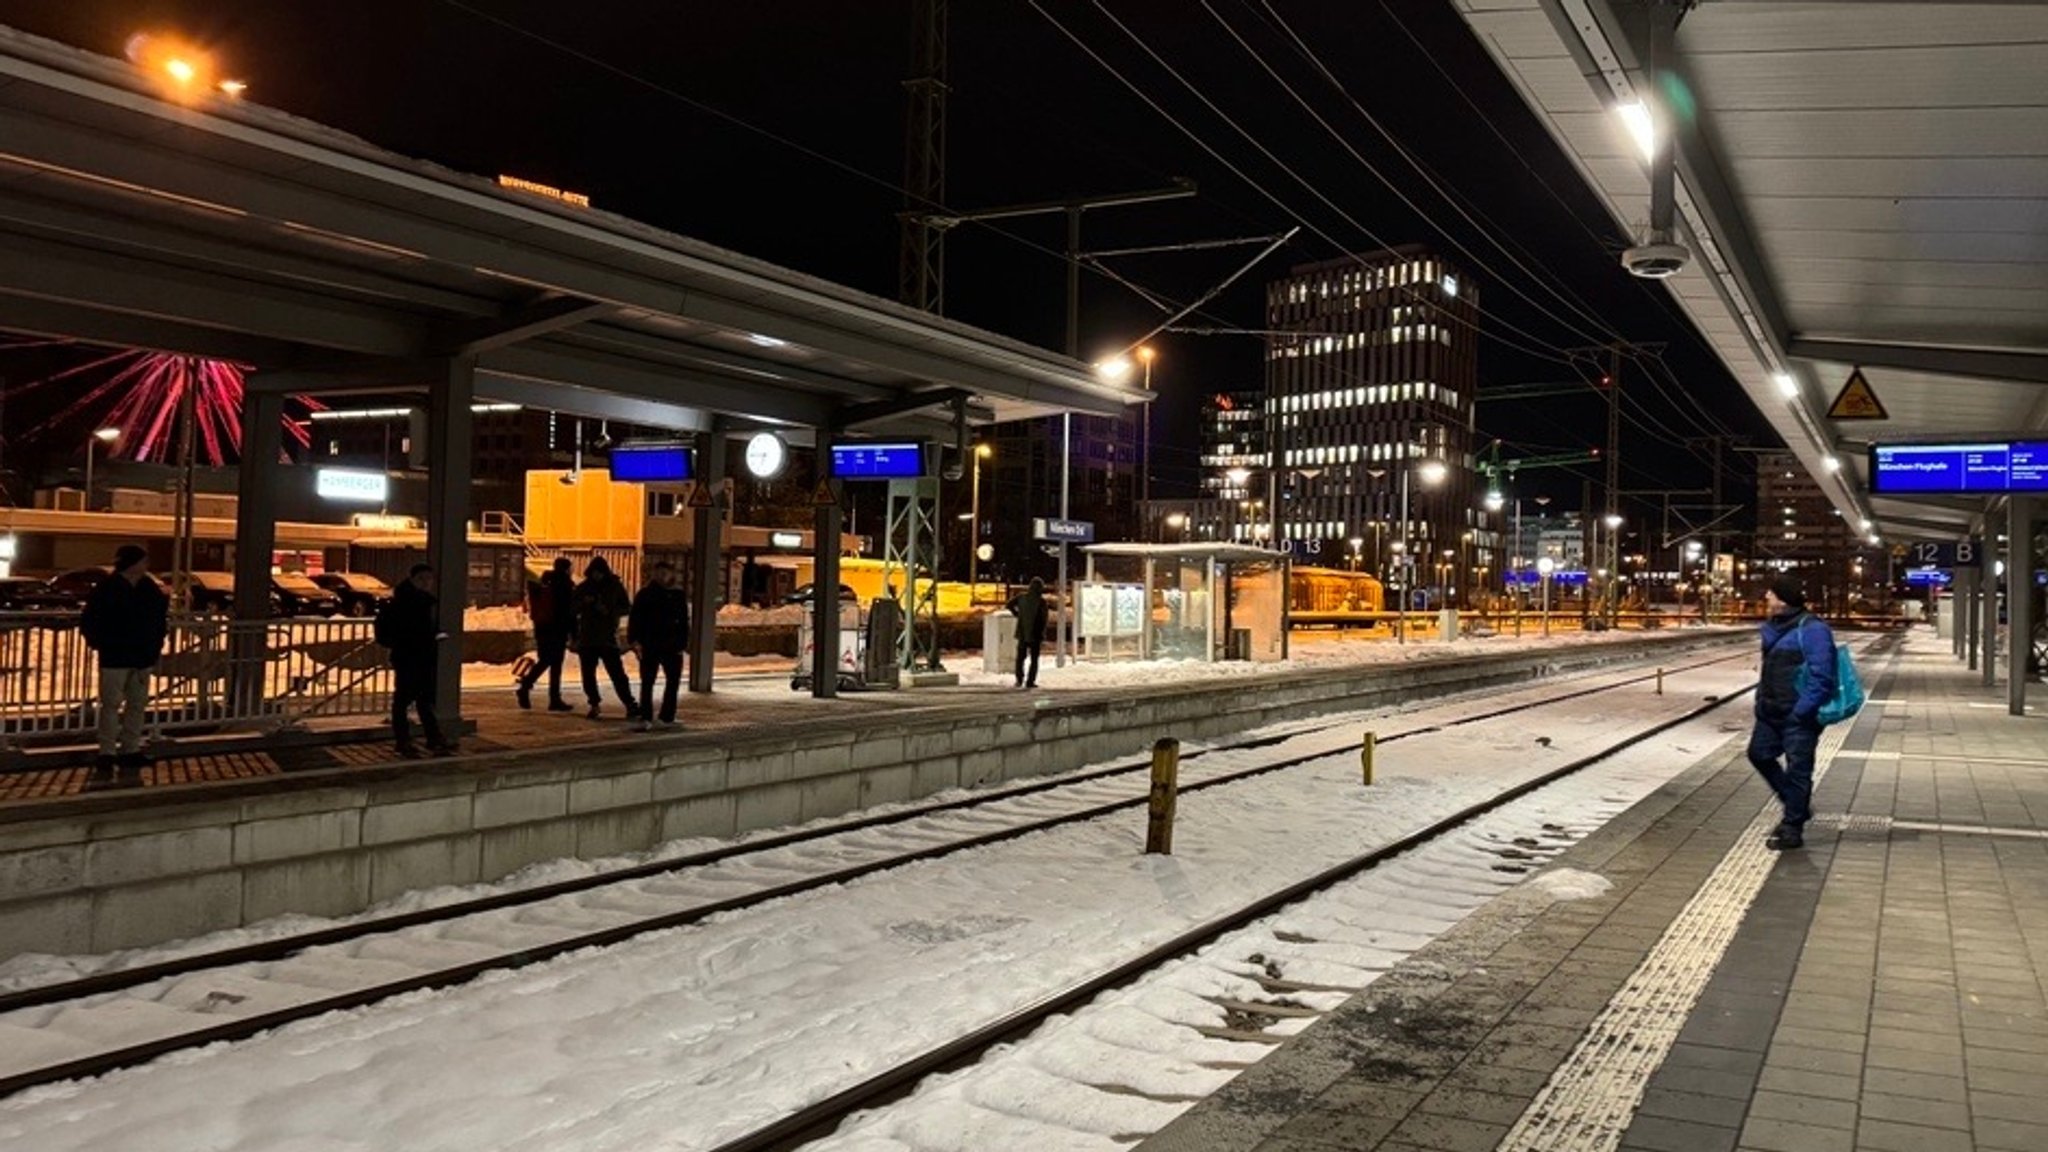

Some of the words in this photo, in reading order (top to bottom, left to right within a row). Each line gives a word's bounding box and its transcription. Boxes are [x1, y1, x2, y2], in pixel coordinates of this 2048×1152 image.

[1304, 538, 1321, 554] 13
[1914, 543, 1939, 562] 12
[1956, 543, 1973, 562] B
